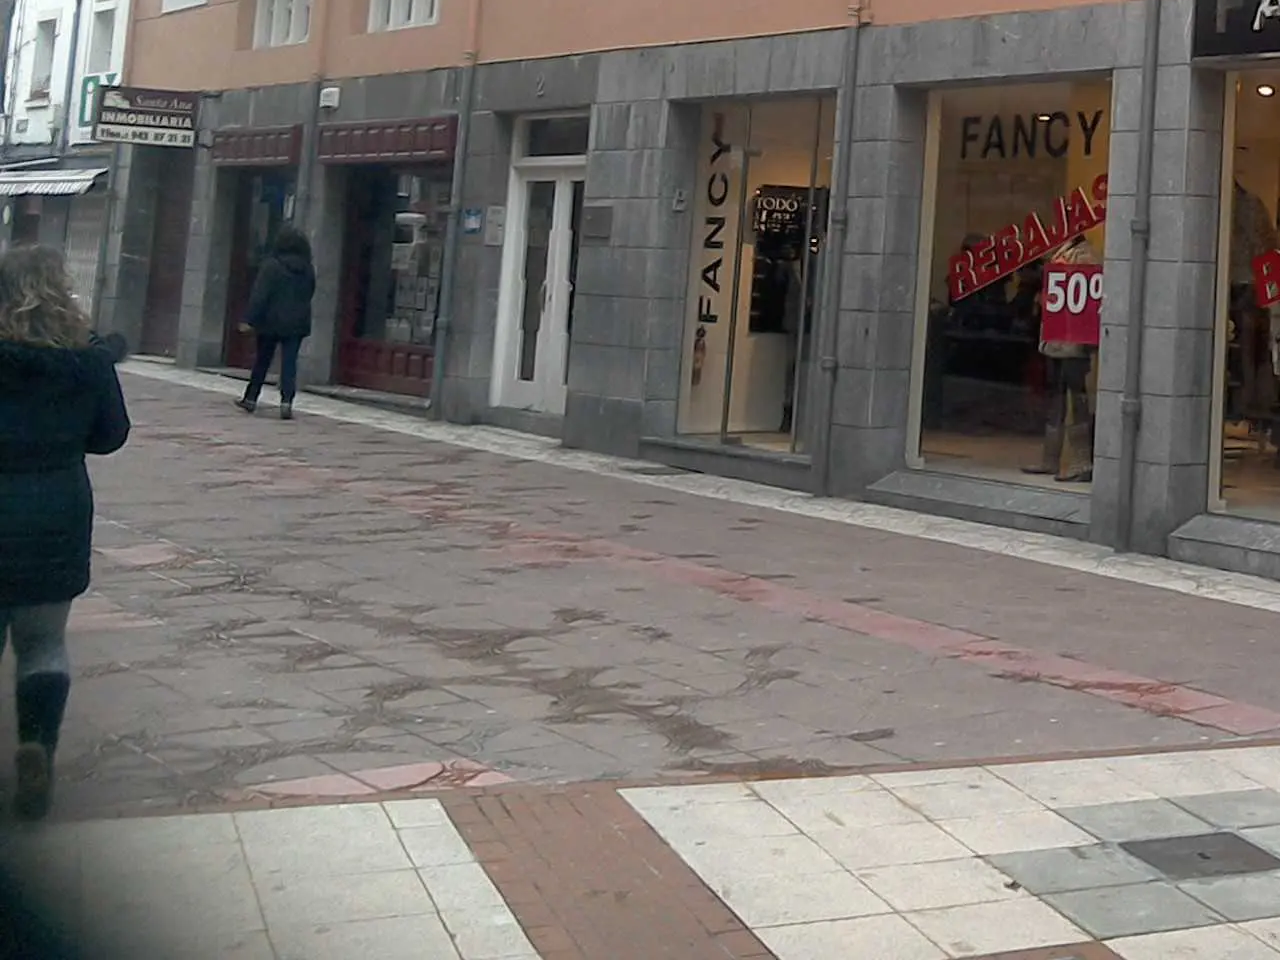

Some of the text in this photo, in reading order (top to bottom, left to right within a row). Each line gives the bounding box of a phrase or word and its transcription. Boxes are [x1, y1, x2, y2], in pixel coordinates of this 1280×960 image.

[101, 111, 193, 129] INMOBILIARIA
[961, 110, 1104, 160] FANCY
[698, 138, 731, 324] FANCY
[948, 174, 1108, 301] REBAJAS
